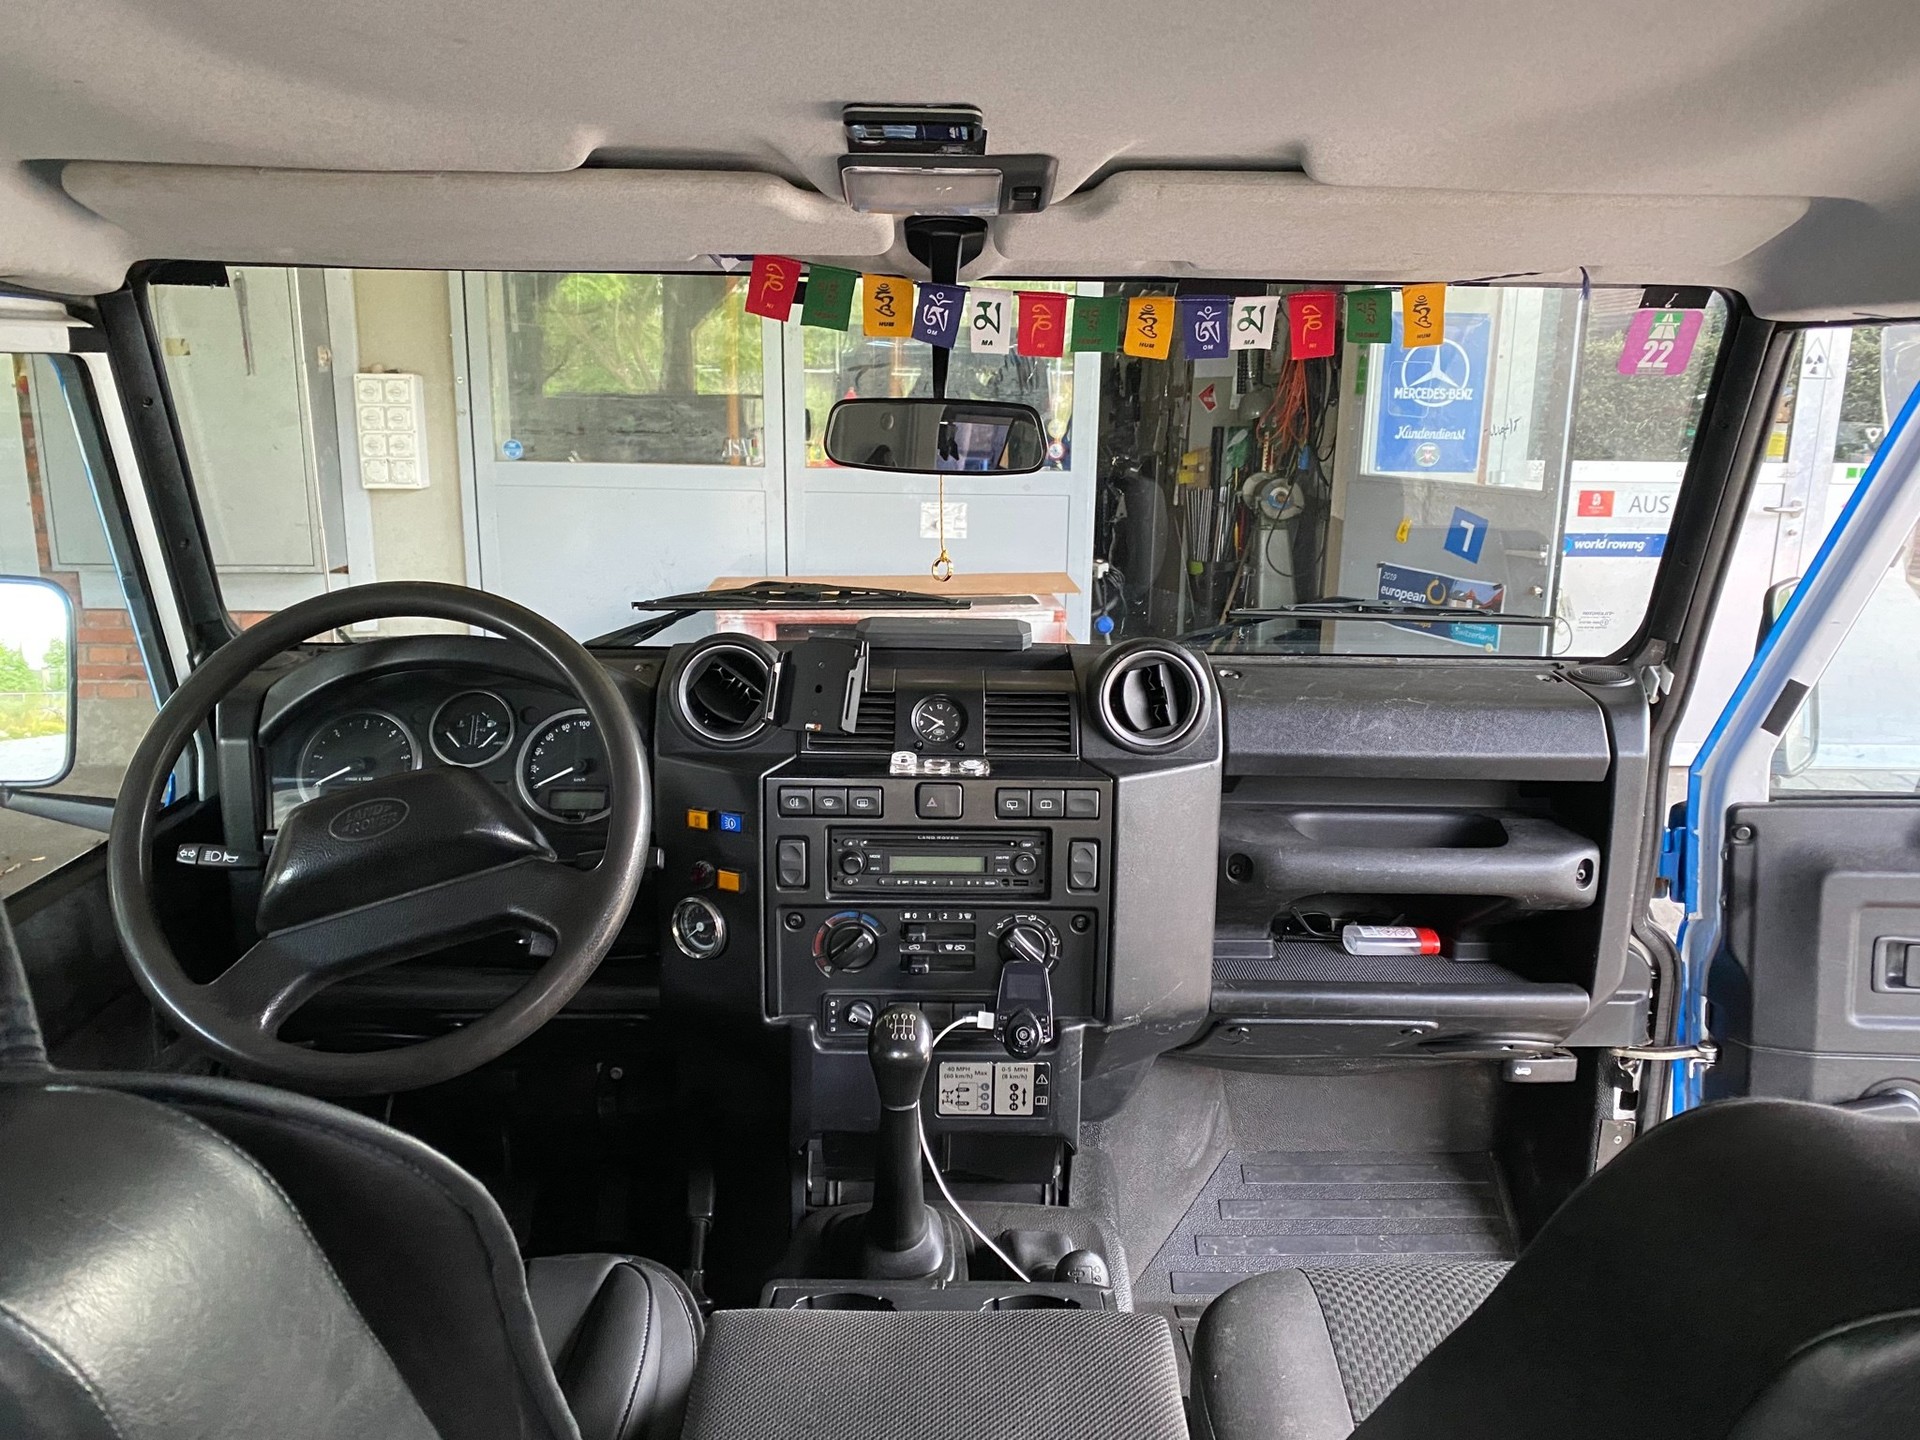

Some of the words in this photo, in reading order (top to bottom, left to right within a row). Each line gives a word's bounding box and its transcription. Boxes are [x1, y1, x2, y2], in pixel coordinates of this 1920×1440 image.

[1139, 341, 1155, 349] HUM
[1637, 340, 1674, 368] 22
[1393, 386, 1474, 401] MERCEDES-BENZ
[1394, 424, 1467, 441] Kundendienst
[1628, 495, 1670, 514] AUS
[1574, 538, 1608, 550] world
[1607, 540, 1646, 552] rowing
[1382, 571, 1397, 581] 2019
[1380, 585, 1427, 603] european
[545, 732, 554, 741] 60
[912, 912, 918, 920] 0
[943, 912, 948, 920] 2
[958, 912, 963, 920] 3
